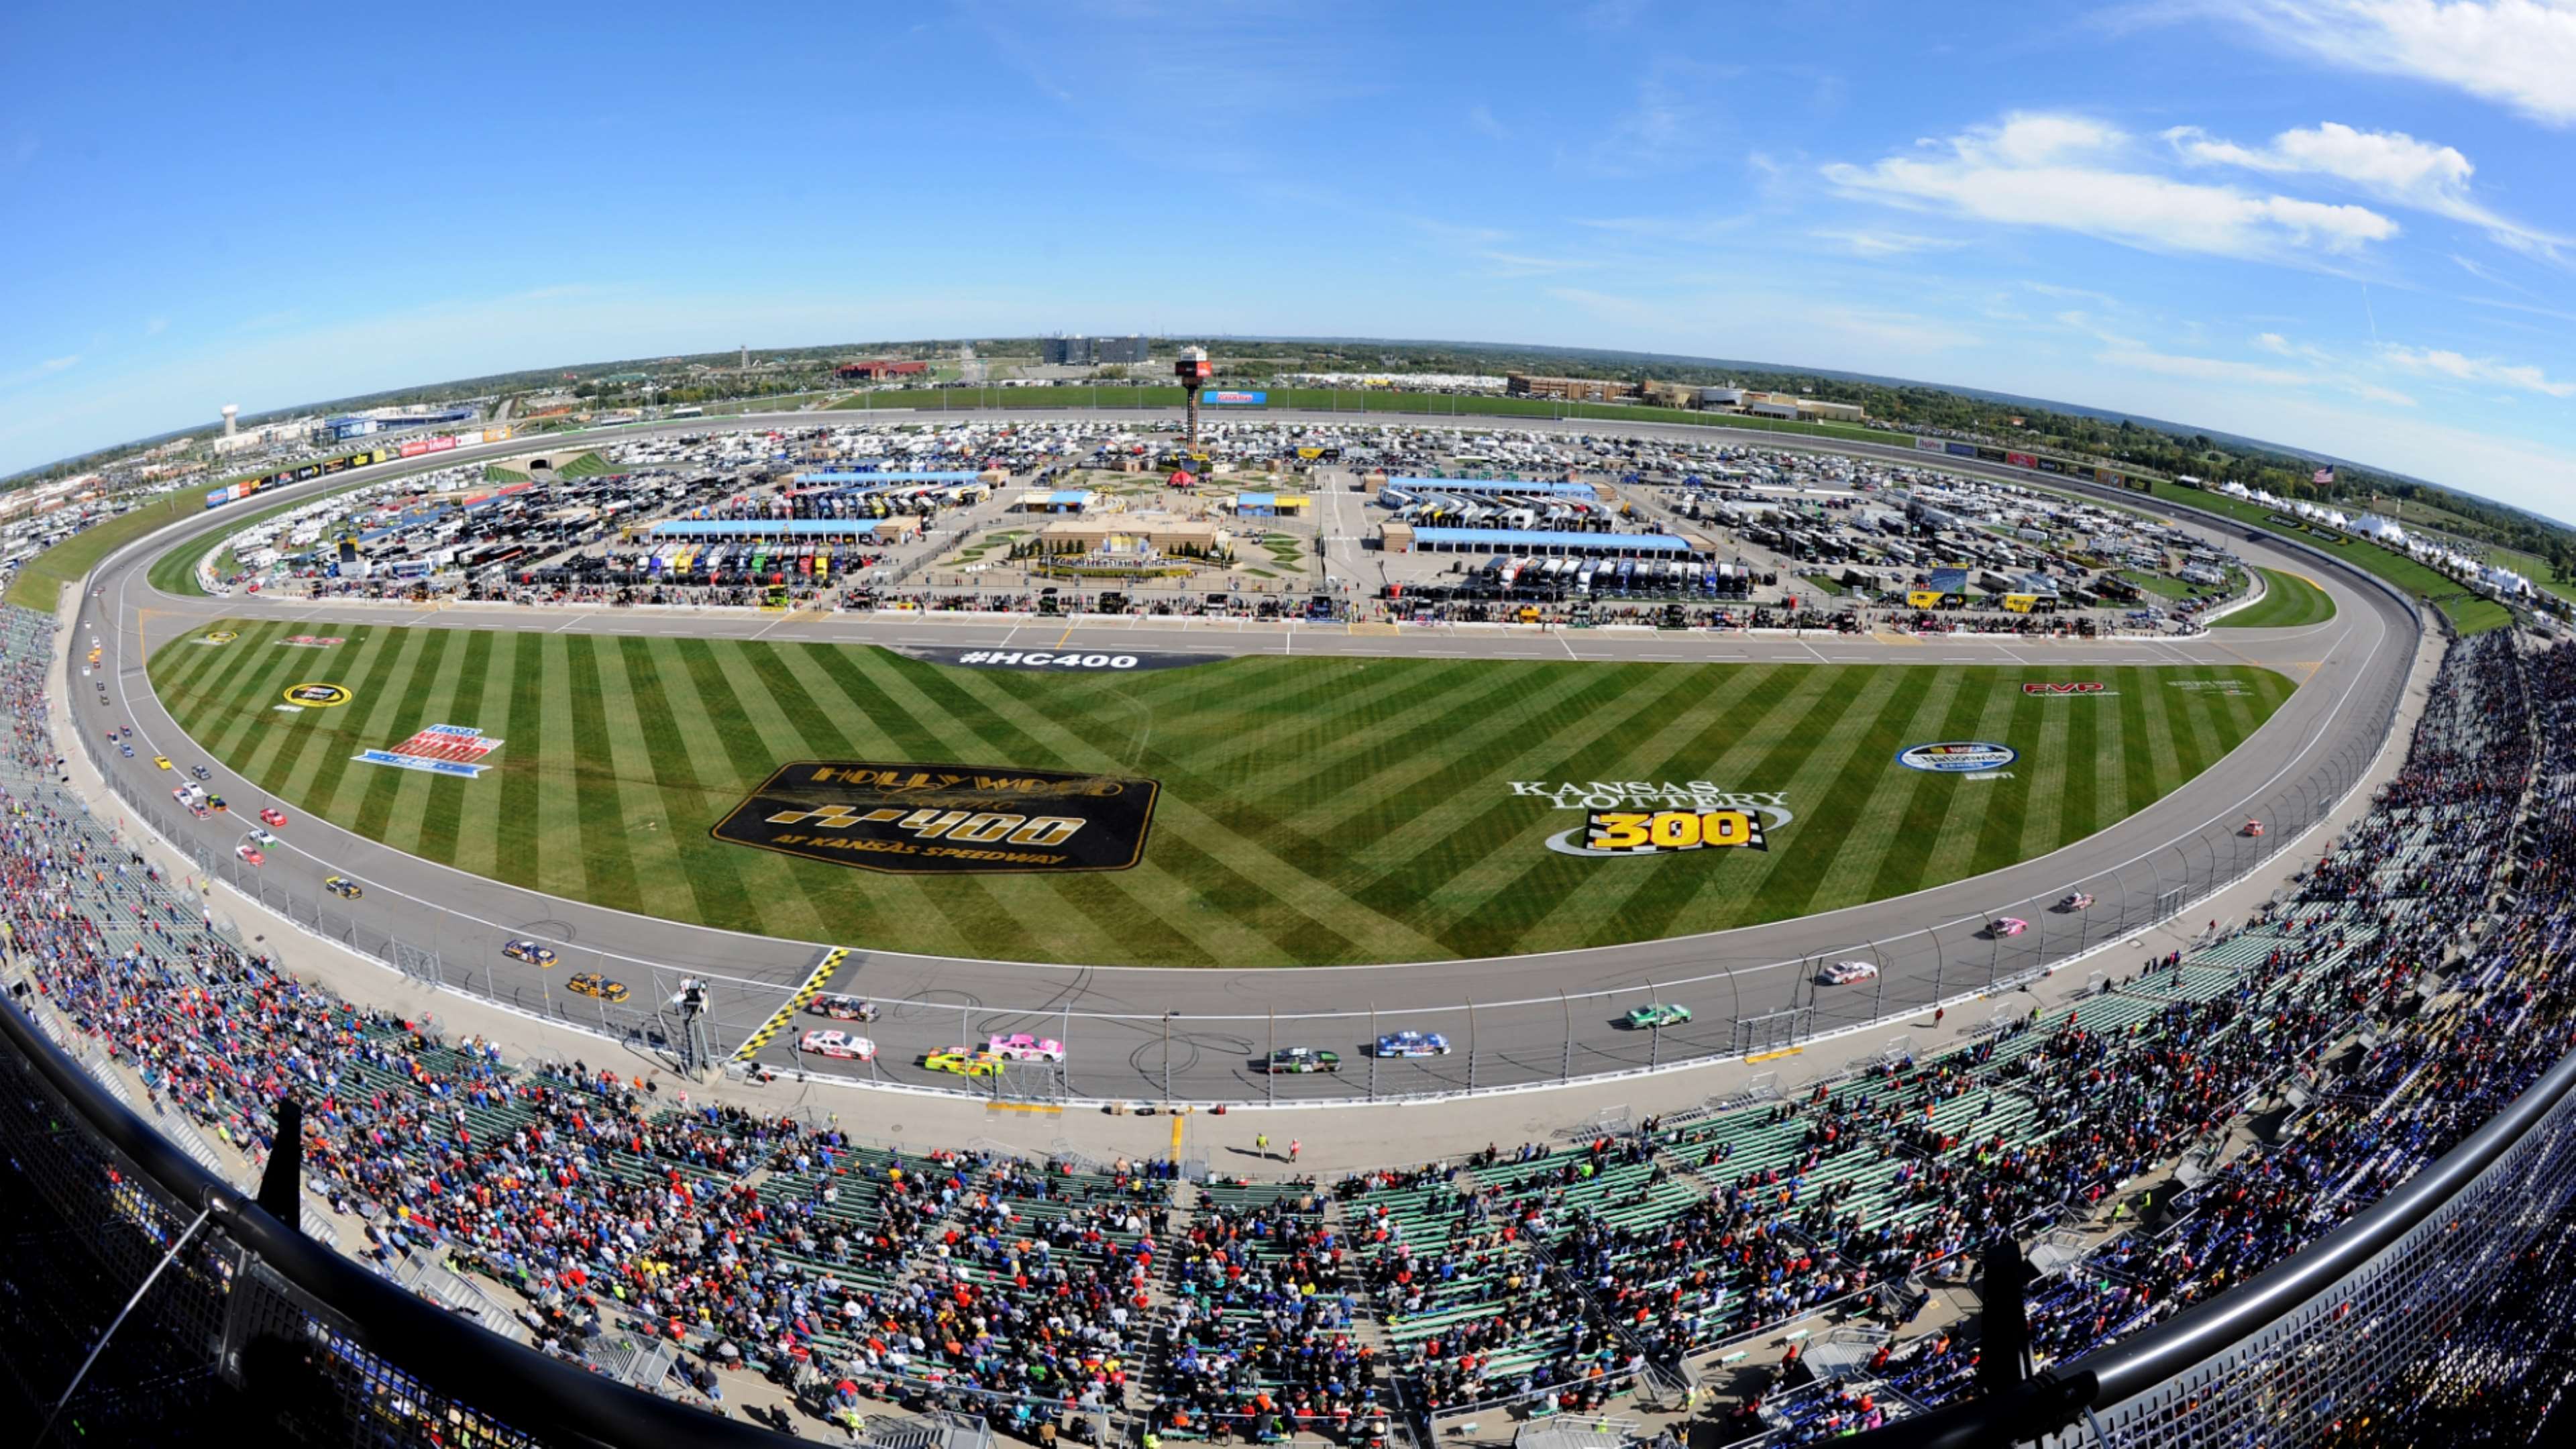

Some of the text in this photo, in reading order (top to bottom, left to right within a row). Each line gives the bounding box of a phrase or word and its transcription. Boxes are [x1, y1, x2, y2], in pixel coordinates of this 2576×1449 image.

[959, 651, 1138, 668] #HC400
[2023, 682, 2104, 694] FVP
[391, 739, 489, 763] GUARD
[1506, 780, 1720, 796] KANSAS
[1548, 792, 1788, 809] LOTTERY
[898, 809, 1087, 847] 400
[1593, 811, 1751, 848] 300
[772, 835, 1068, 865] AT KANSAS SPEEDWAY
